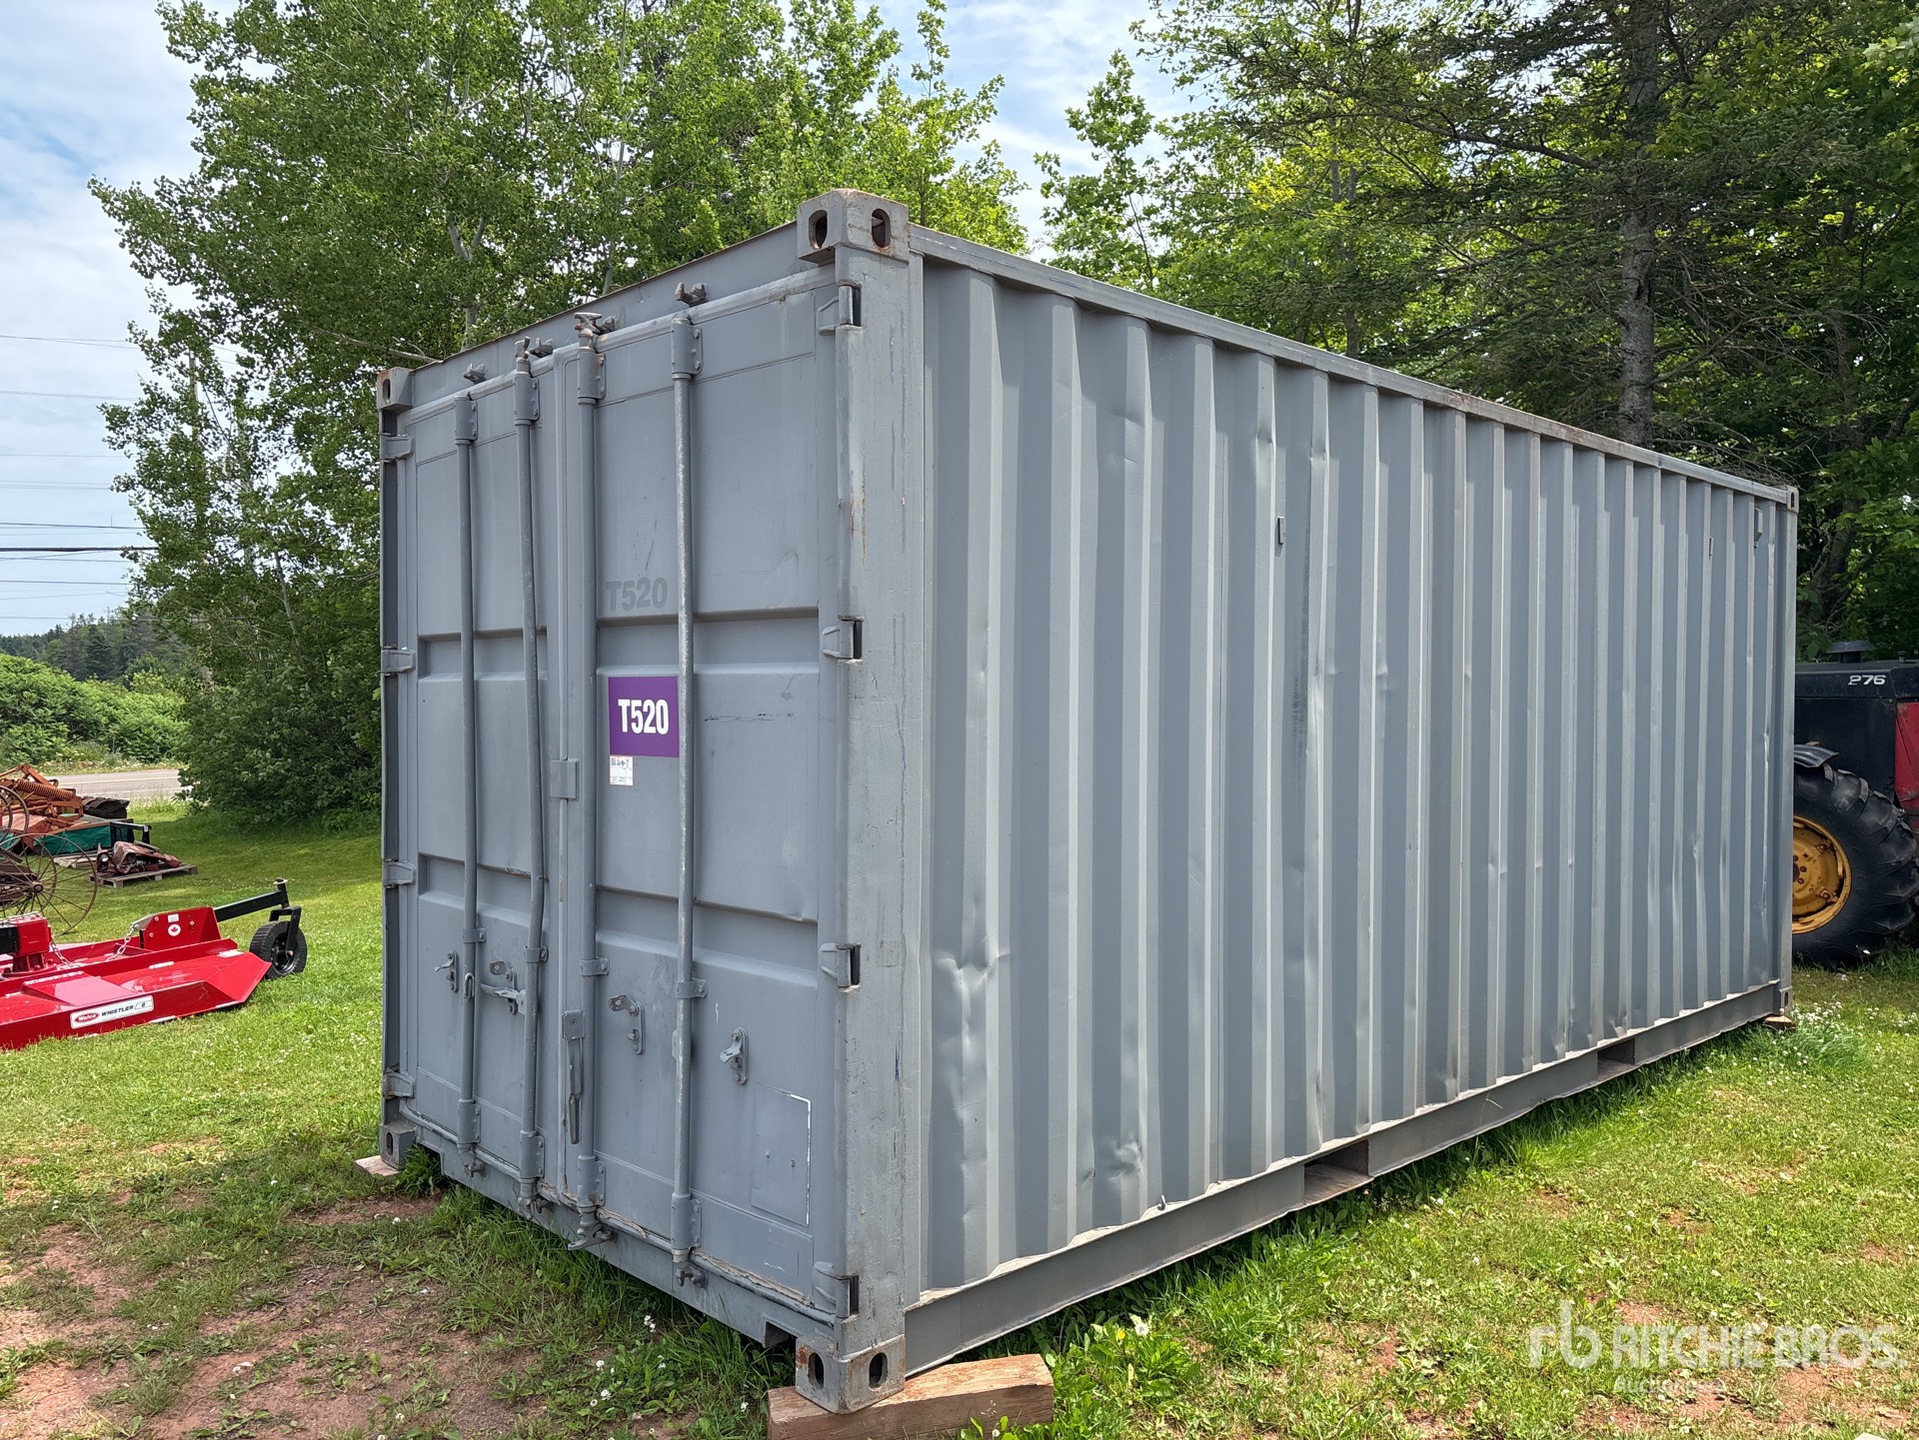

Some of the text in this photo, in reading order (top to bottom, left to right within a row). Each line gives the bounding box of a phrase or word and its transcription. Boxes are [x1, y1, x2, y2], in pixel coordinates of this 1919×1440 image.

[605, 577, 668, 612] T520
[1847, 674, 1887, 686] 276
[617, 698, 669, 735] T520
[101, 1005, 134, 1017] WHISTLER
